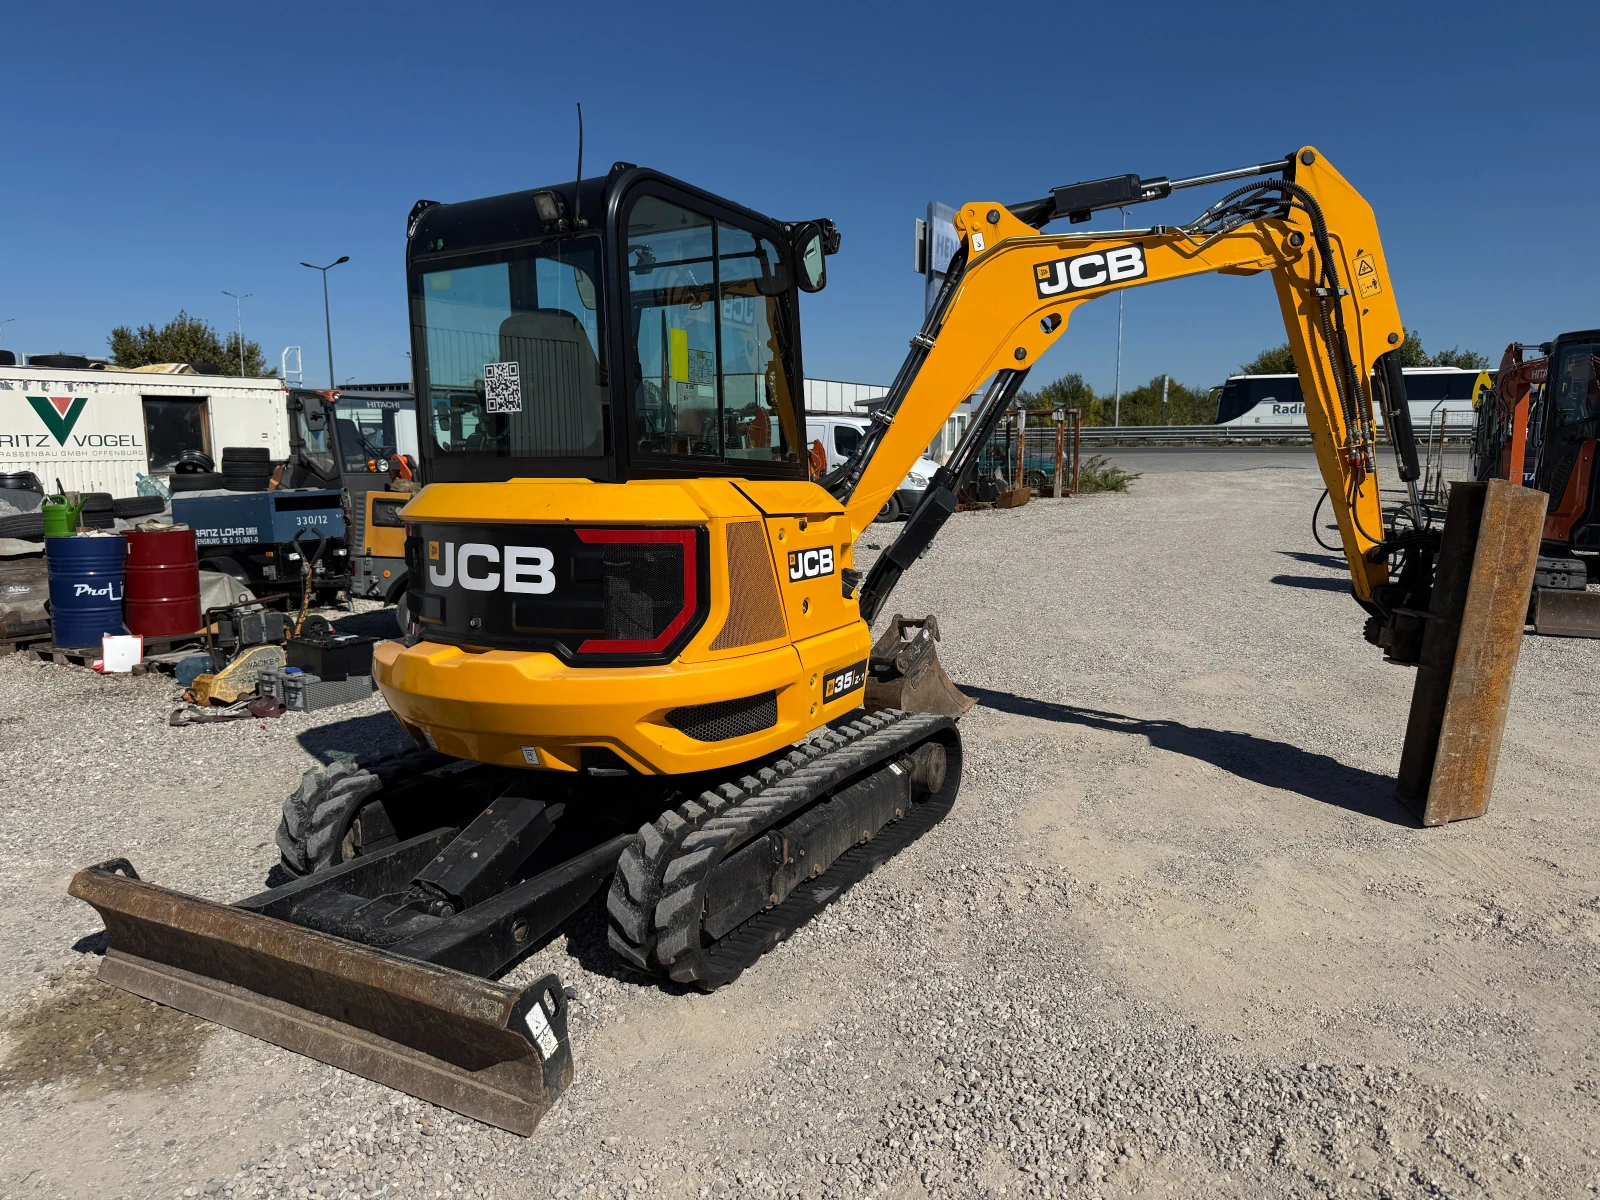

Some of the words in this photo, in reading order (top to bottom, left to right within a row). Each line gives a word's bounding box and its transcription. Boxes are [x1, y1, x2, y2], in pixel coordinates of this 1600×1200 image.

[1038, 246, 1145, 295] JCB
[366, 401, 401, 409] HITACHI
[72, 434, 143, 448] VOGEL
[92, 449, 144, 457] OFFENBURG
[296, 515, 329, 526] 330/12
[220, 527, 245, 536] LOHR
[429, 542, 556, 595] JCB
[789, 548, 834, 581] JCB
[245, 657, 280, 669] WACKER
